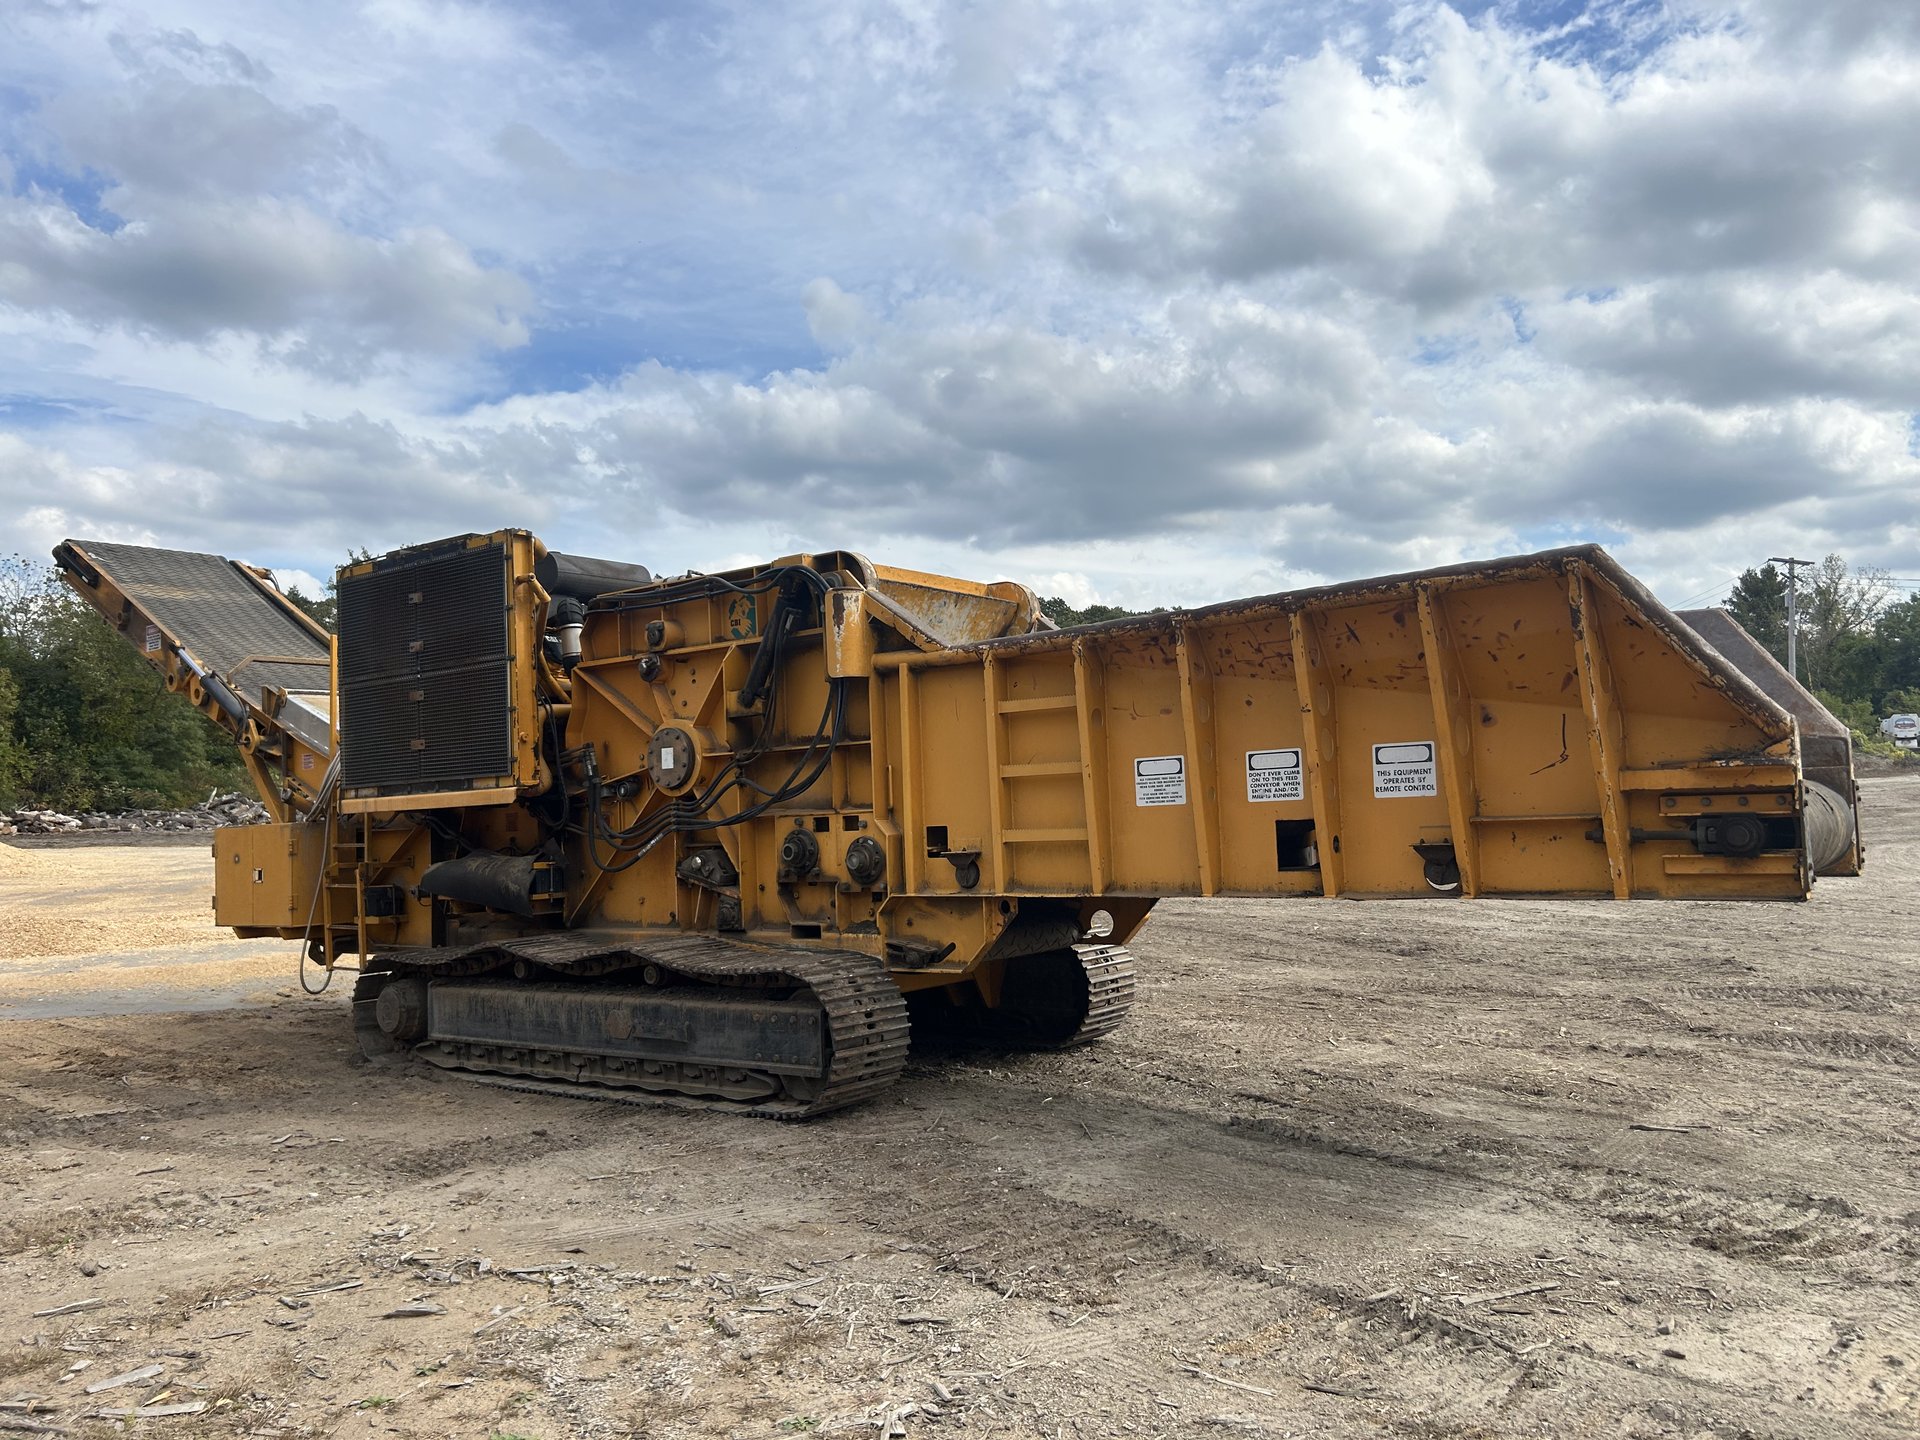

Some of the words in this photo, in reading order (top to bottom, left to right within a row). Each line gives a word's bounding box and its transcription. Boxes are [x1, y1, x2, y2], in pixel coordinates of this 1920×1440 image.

[1393, 768, 1432, 776] EQUIPMENT
[1383, 777, 1415, 785] OPERATES
[1375, 785, 1401, 793] REMOTE
[1403, 784, 1435, 792] CONTROL
